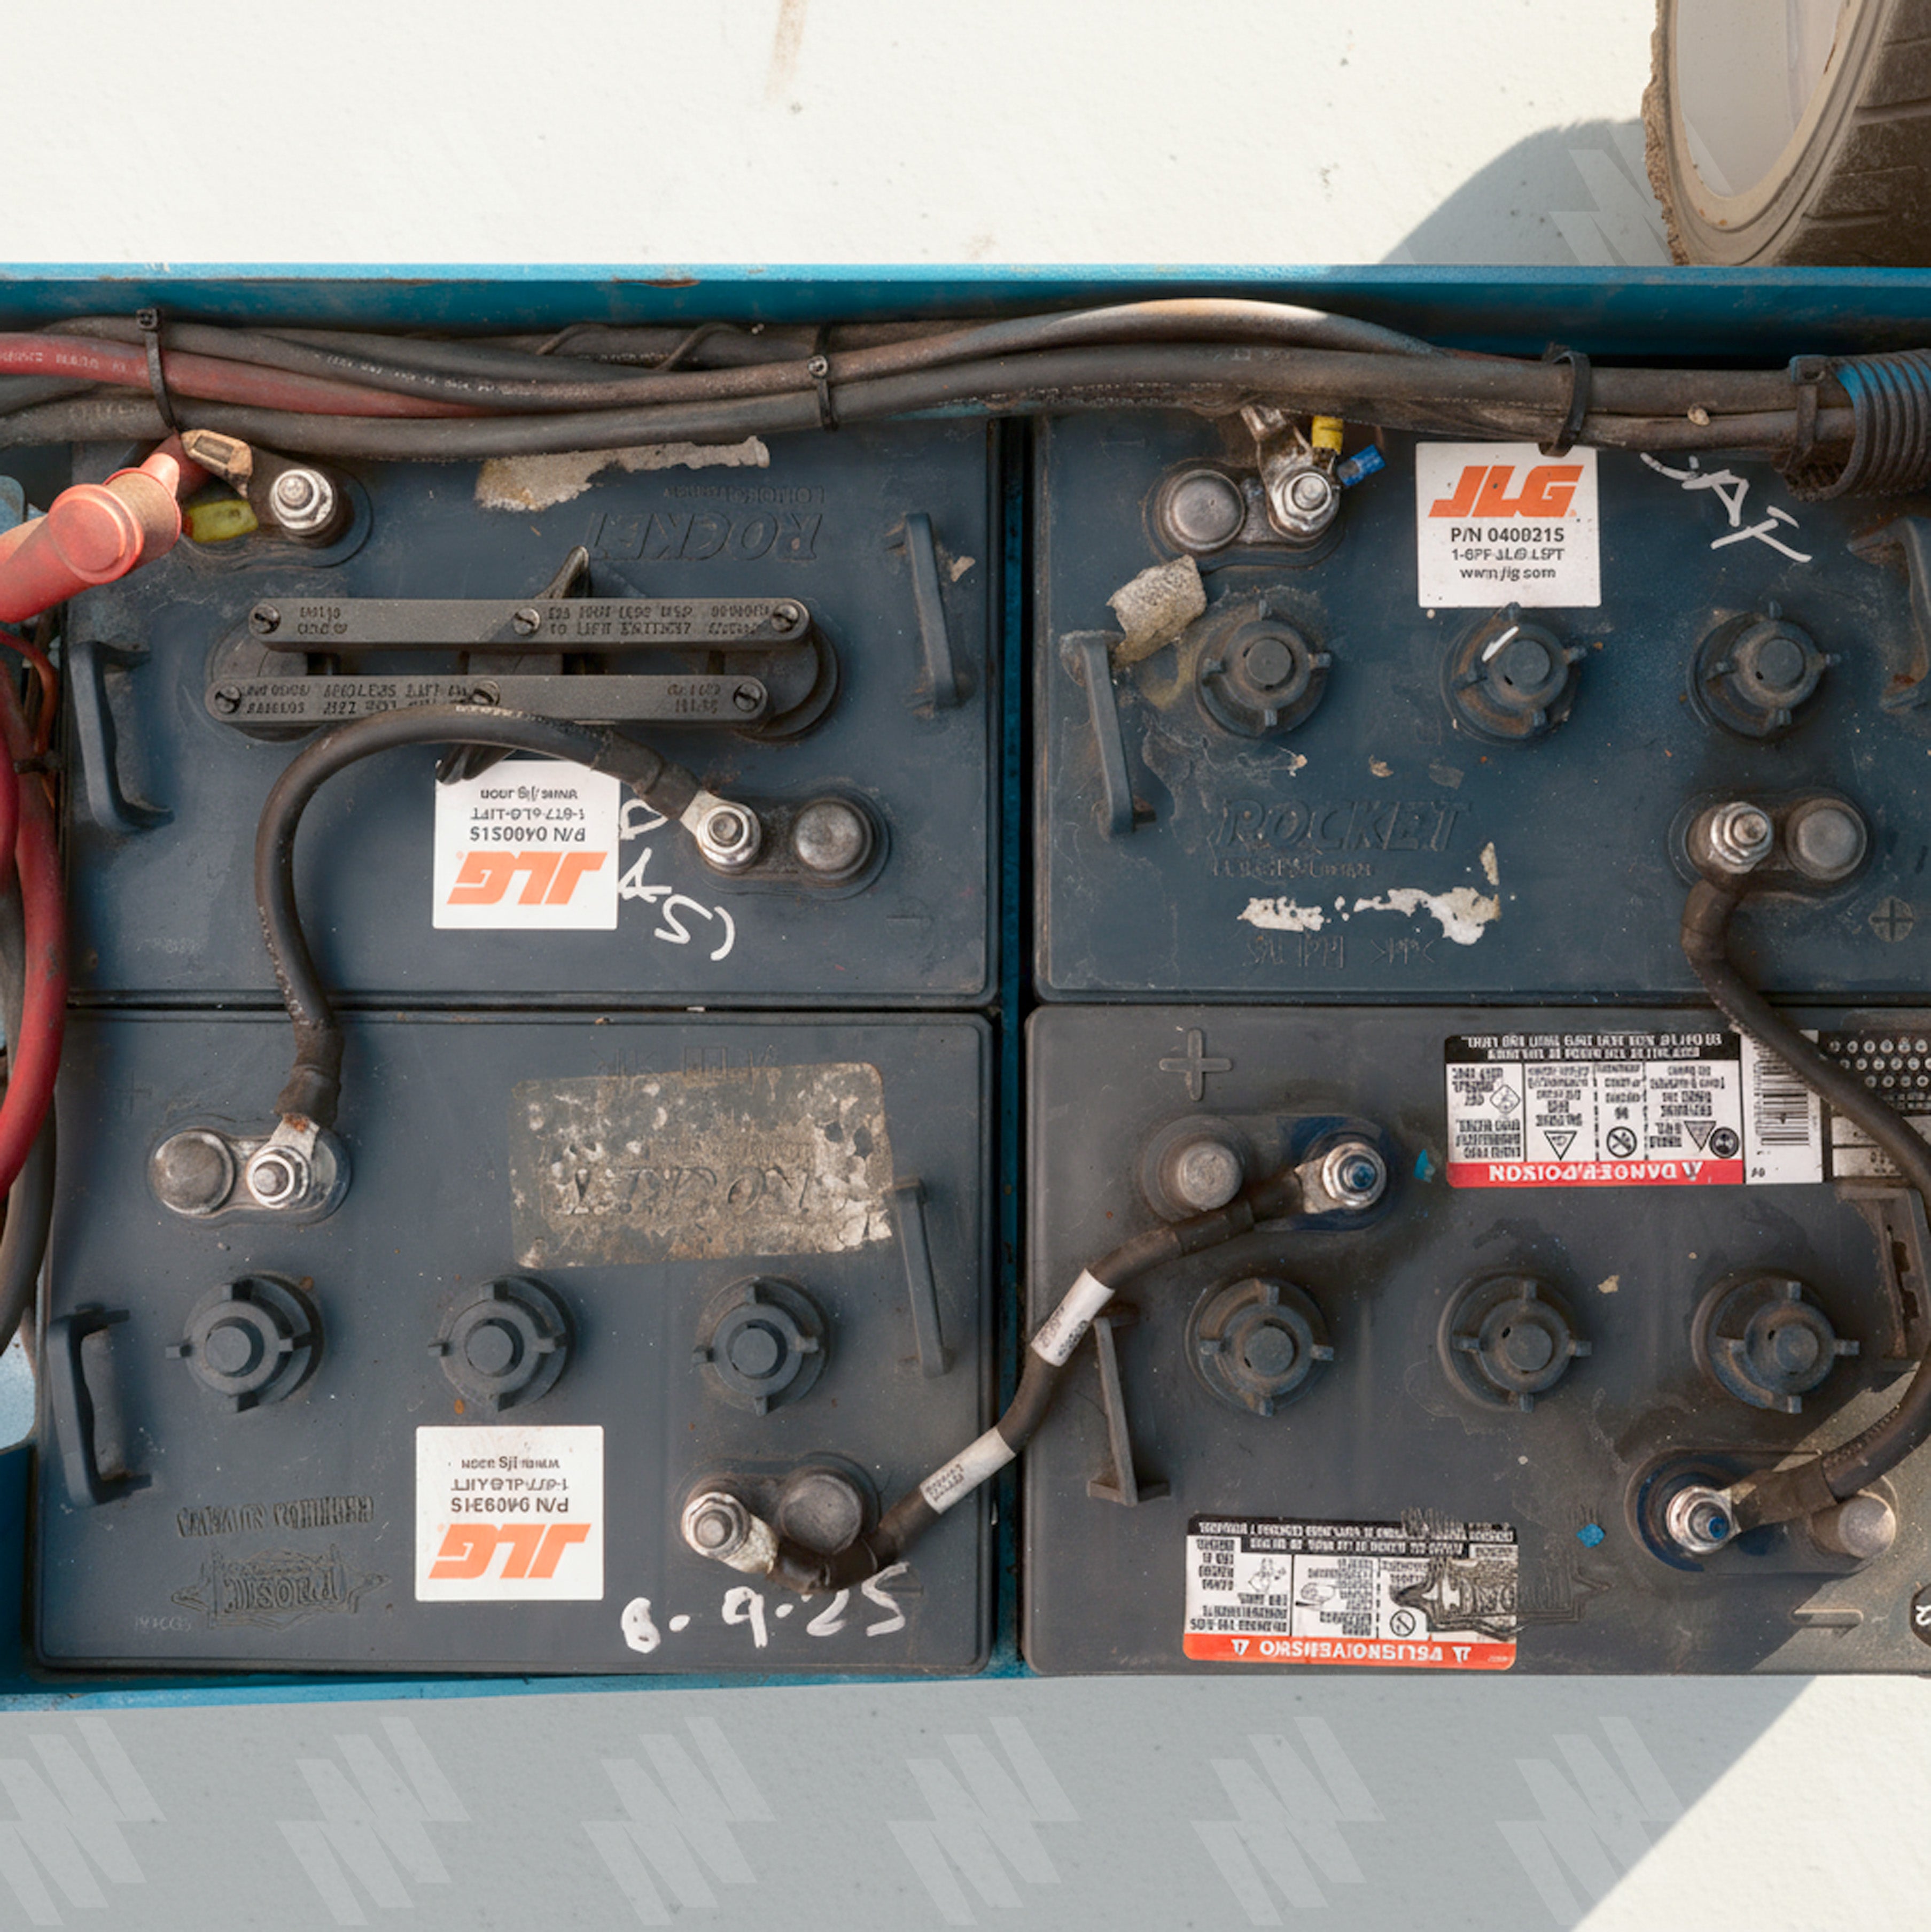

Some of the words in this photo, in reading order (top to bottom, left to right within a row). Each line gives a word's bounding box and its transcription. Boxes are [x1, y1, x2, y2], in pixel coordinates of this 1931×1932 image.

[1428, 465, 1584, 517] JLG
[1451, 527, 1481, 542] P/N
[1218, 798, 1472, 851] ROCKET
[447, 851, 608, 904] JLG
[428, 1523, 591, 1579] JLG
